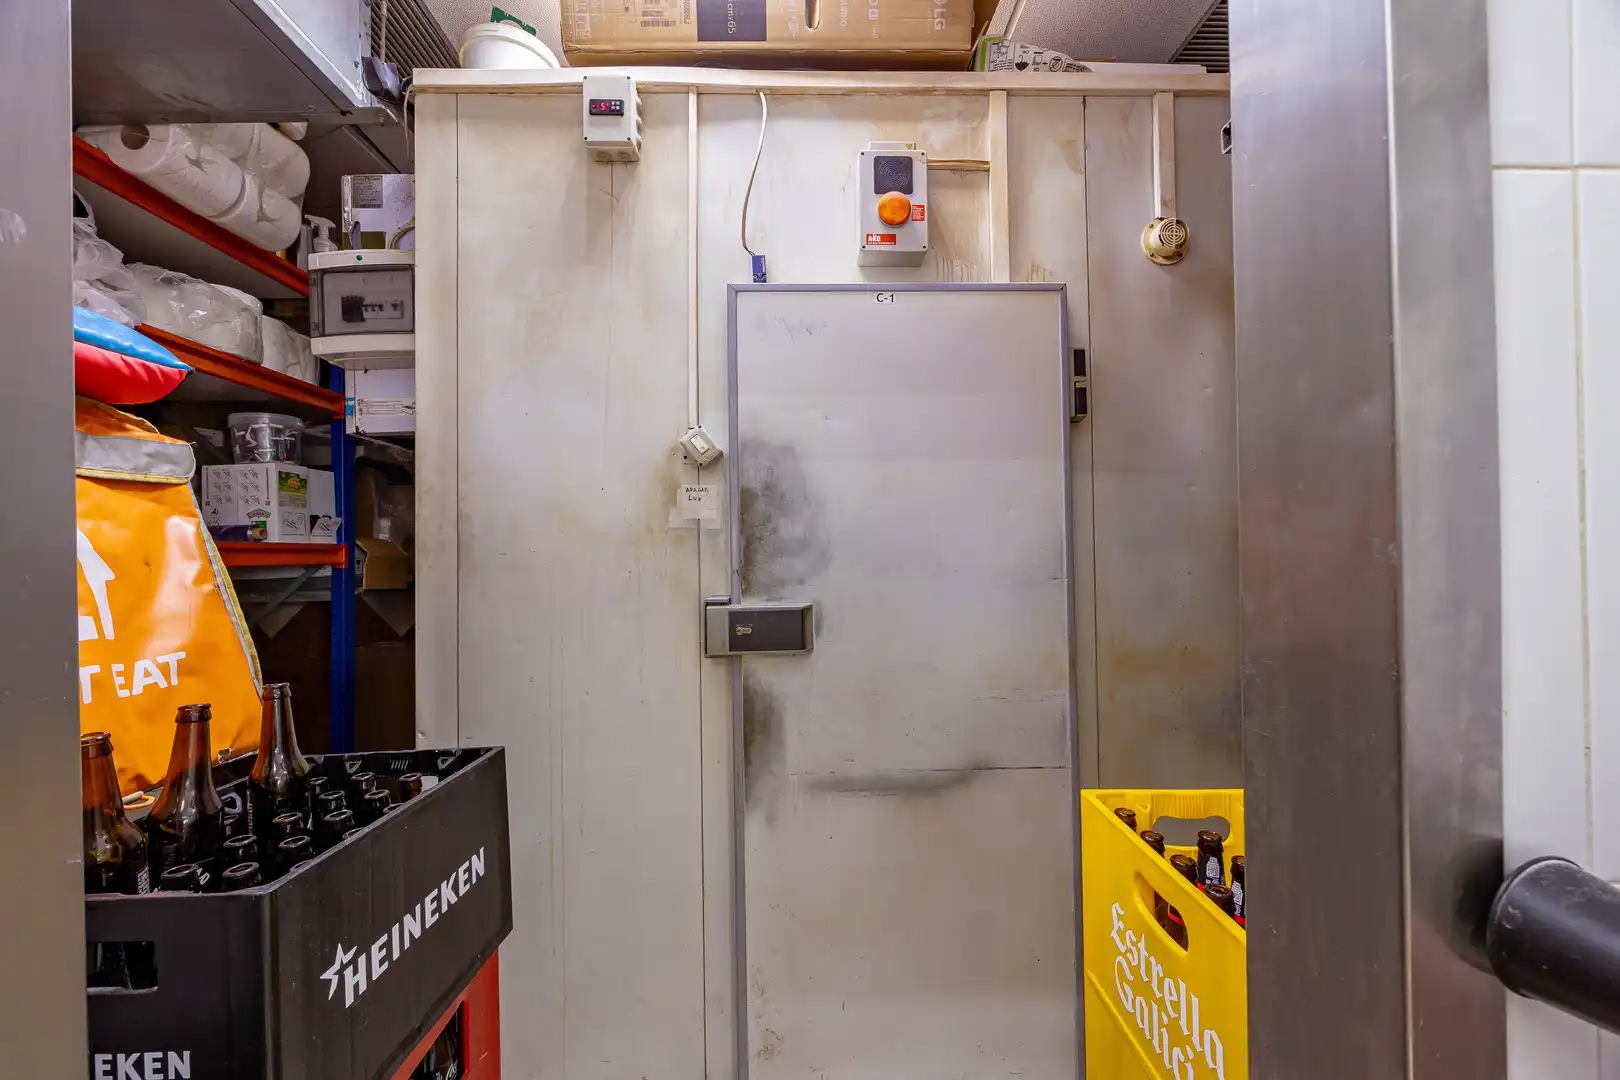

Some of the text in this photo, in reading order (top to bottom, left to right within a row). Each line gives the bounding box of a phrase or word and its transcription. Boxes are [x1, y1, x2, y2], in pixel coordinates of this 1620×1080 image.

[934, 8, 947, 30] LG
[876, 292, 894, 303] C-1
[111, 651, 186, 698] EAT
[344, 846, 486, 1009] HEINEKEN
[1110, 902, 1225, 1080] Estrella
[94, 1050, 191, 1080] EKEN
